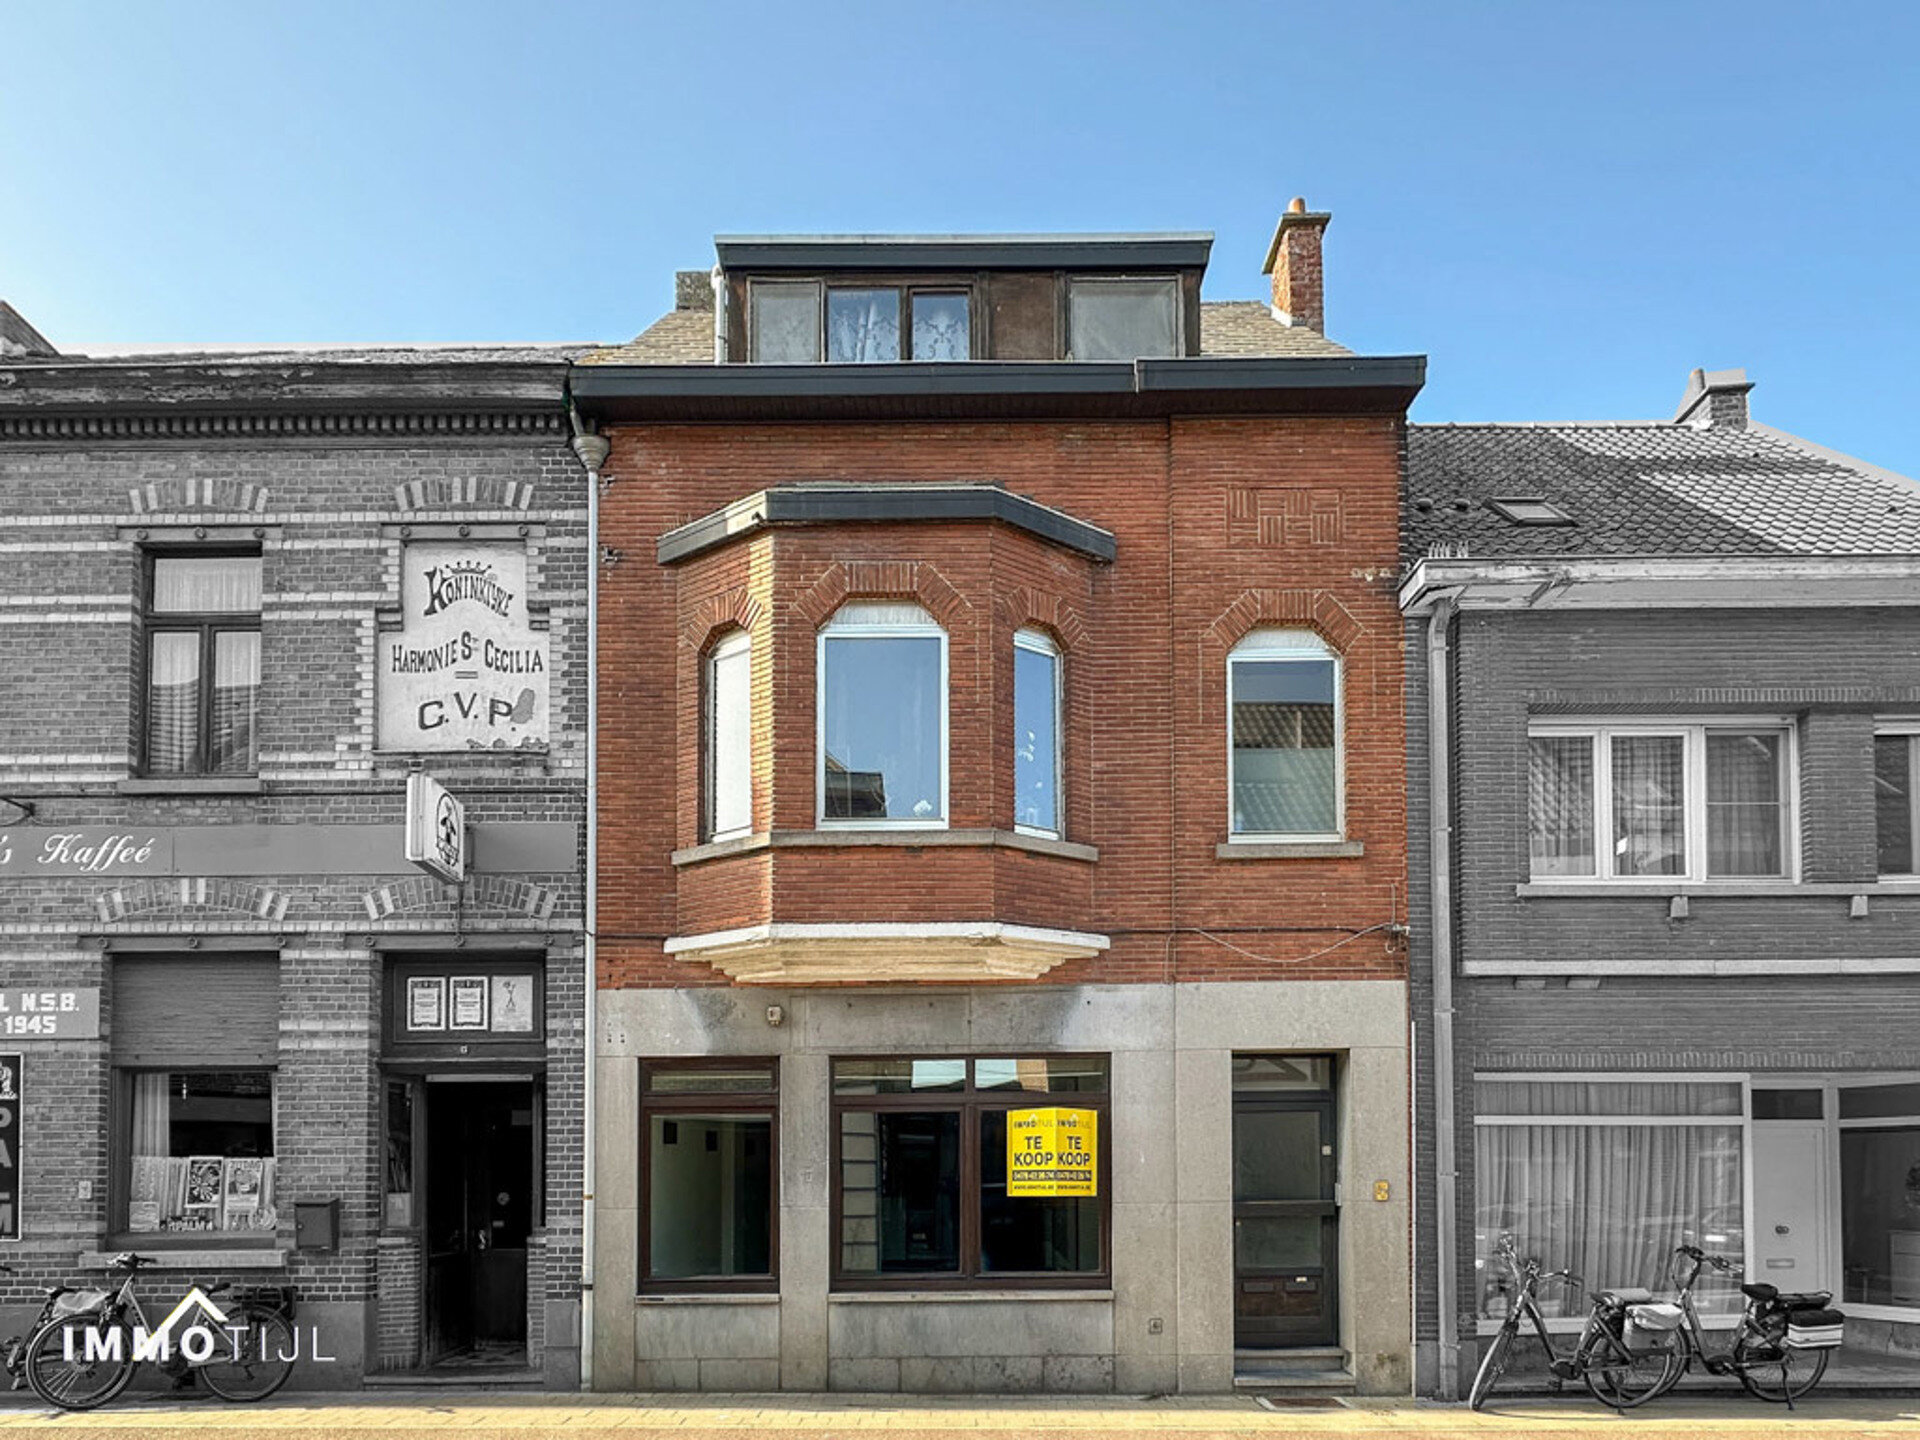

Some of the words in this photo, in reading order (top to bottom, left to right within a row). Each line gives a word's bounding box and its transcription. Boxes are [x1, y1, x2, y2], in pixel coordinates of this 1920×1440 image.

[392, 638, 458, 673] HARMONIE
[485, 639, 544, 673] CECILIA
[37, 833, 156, 872] Kaffeé
[21, 993, 80, 1012] N.S.B.
[1025, 1135, 1043, 1150] TE
[1067, 1135, 1082, 1150] TE
[1014, 1152, 1054, 1166] KOOP
[1057, 1152, 1091, 1166] KOOP
